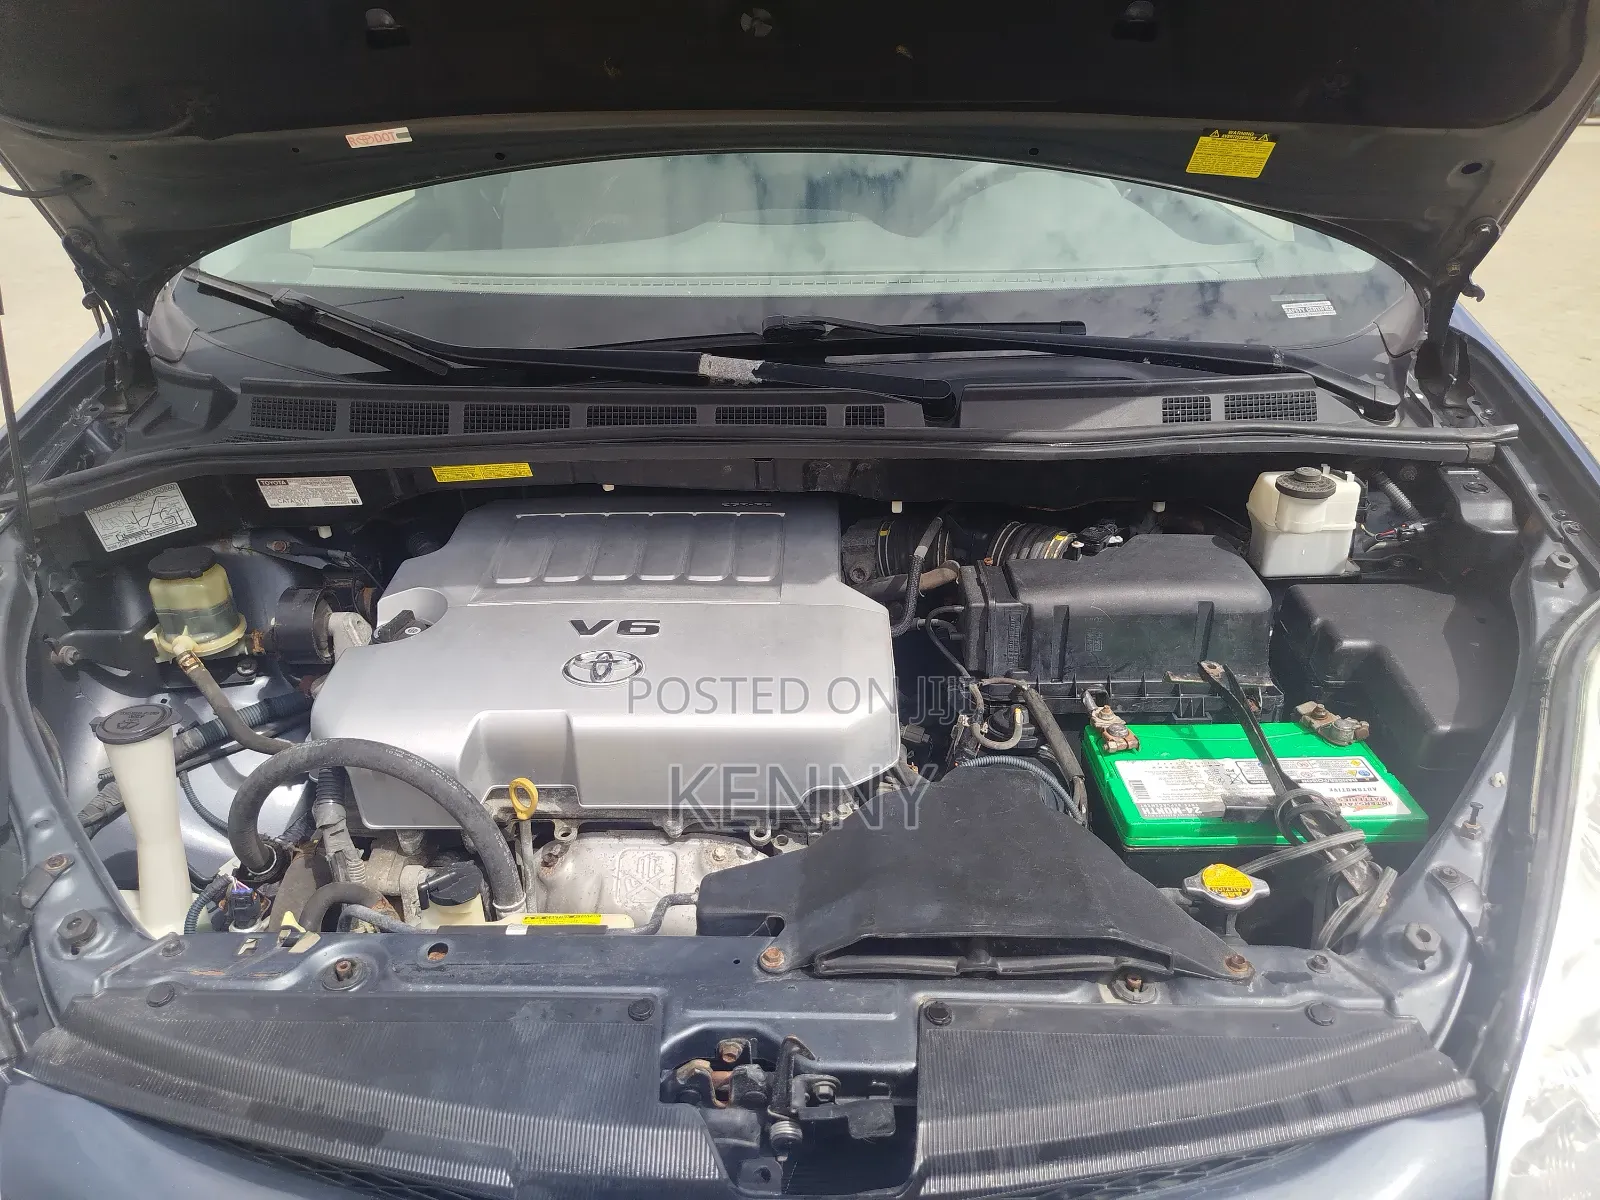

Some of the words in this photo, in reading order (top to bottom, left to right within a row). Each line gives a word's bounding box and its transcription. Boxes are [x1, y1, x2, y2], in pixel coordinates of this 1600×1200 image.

[374, 132, 396, 143] DOT
[569, 619, 661, 637] V6
[1141, 806, 1201, 815] 24-MONTH
